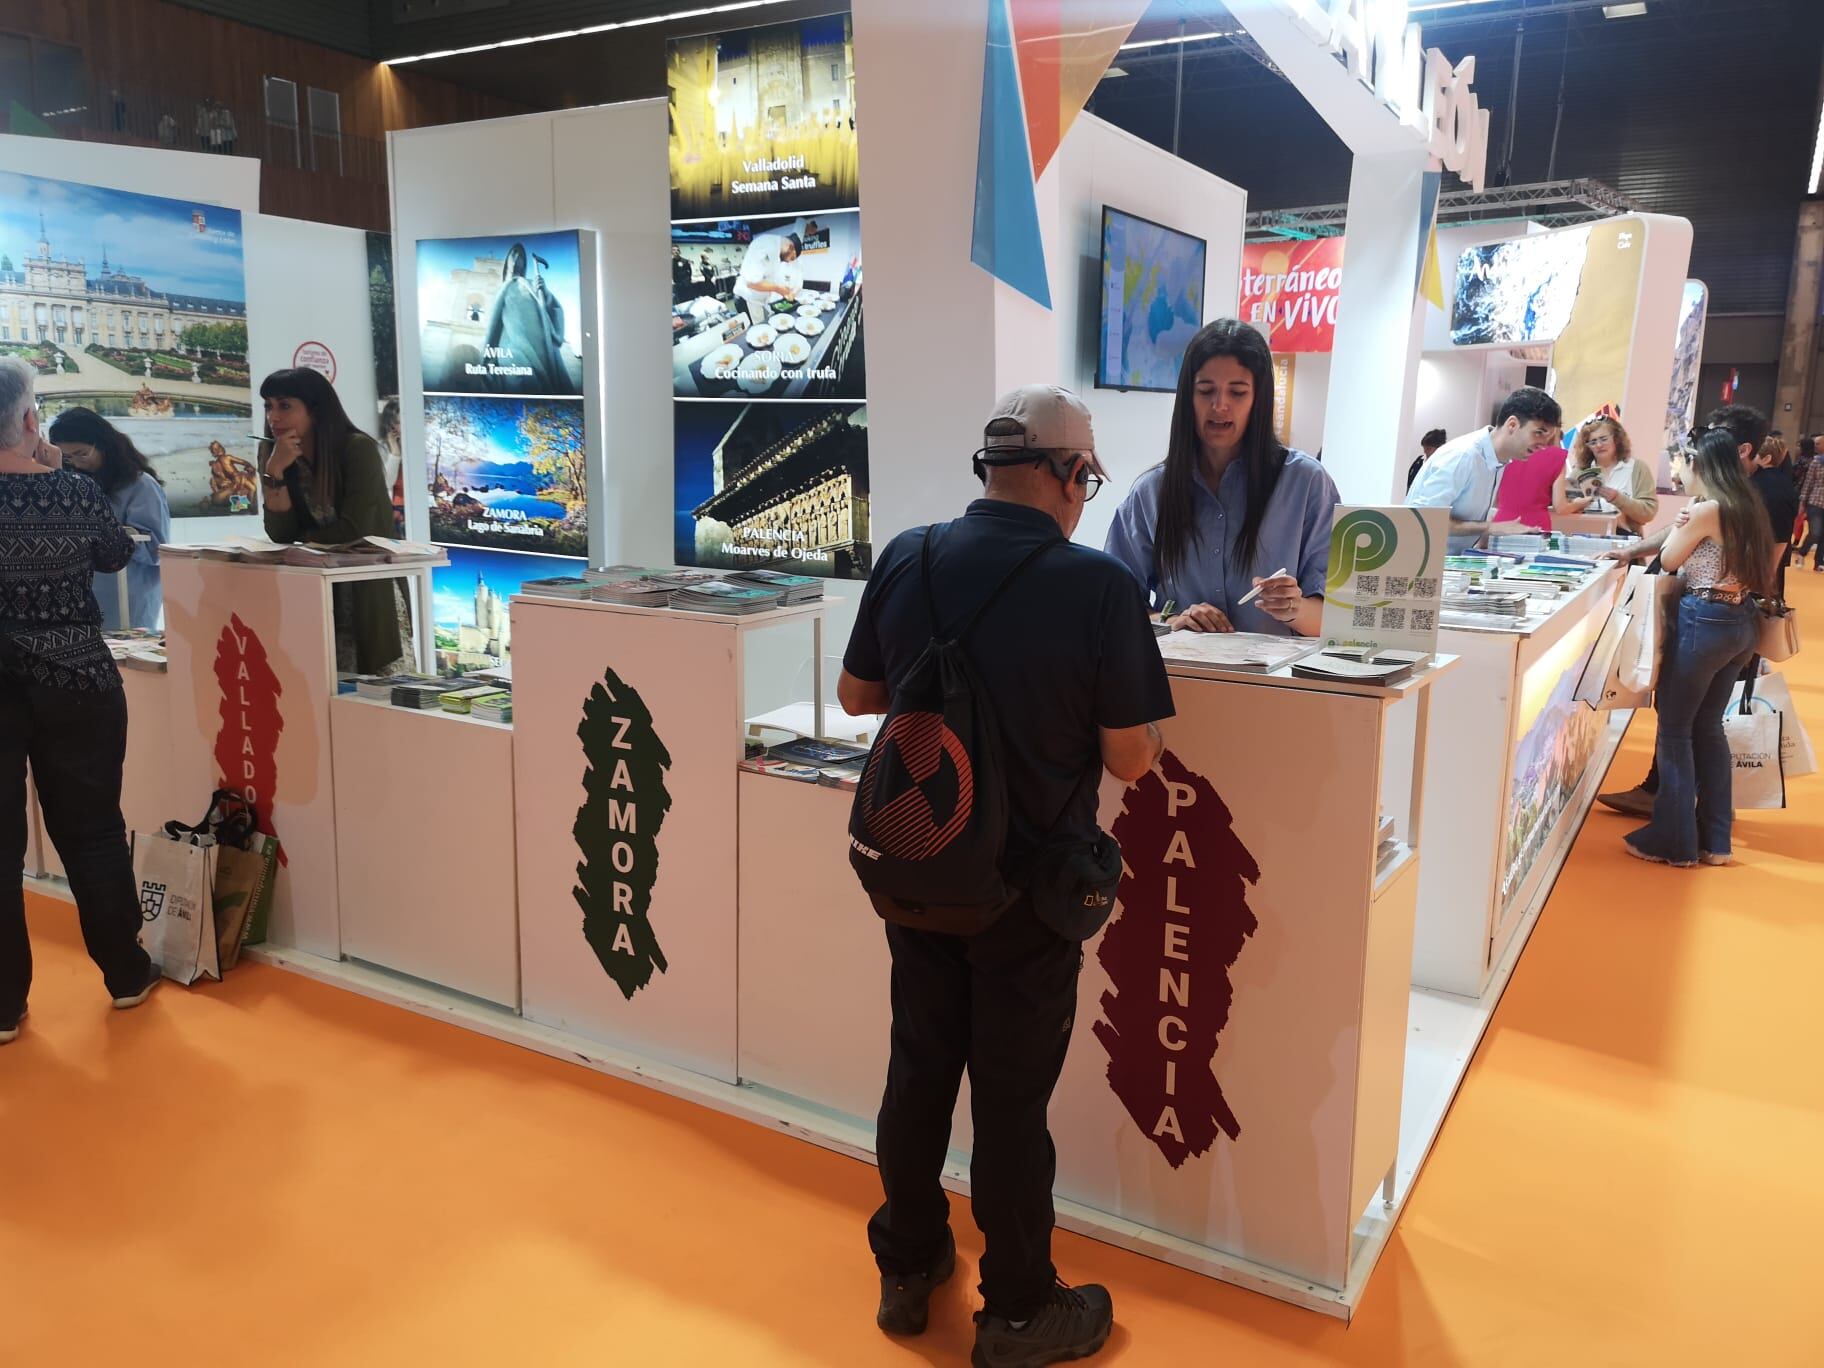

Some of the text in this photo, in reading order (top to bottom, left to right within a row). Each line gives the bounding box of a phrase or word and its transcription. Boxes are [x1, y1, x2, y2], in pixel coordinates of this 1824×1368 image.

[743, 154, 804, 173] Valladolid
[731, 175, 816, 194] Semana Santa
[1243, 264, 1343, 296] terráneo
[1251, 300, 1277, 323] EN
[484, 343, 513, 359] ÁVILA
[465, 363, 533, 376] Ruta Teresiana
[715, 365, 837, 380] Cocinando con trufa
[482, 507, 527, 521] ZAMORA
[490, 521, 503, 532] de
[743, 527, 805, 541] PALENCIA
[721, 543, 828, 562] Moarves de Ojeda
[237, 636, 257, 804] VALLADO
[608, 715, 637, 957] ZAMORA
[1152, 781, 1197, 1144] PALENCIA
